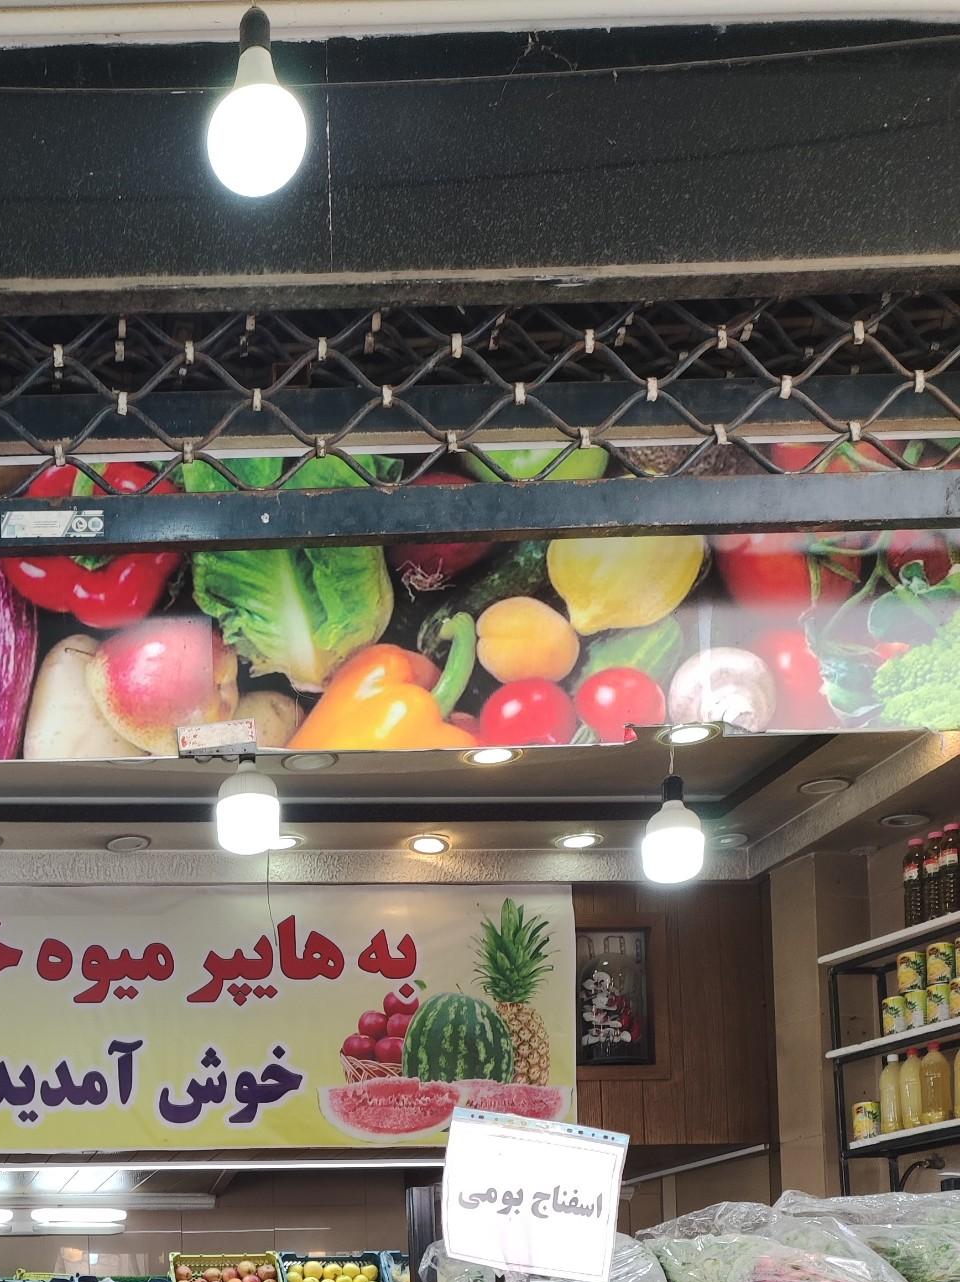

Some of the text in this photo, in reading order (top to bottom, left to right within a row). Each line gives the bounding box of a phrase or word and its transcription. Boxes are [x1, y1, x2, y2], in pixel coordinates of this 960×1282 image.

[37, 938, 174, 1003] میوه
[187, 915, 344, 1006] هایپر
[358, 929, 416, 998] به
[159, 1045, 303, 1123] خوش
[458, 1185, 602, 1219] اسفناج بومی
